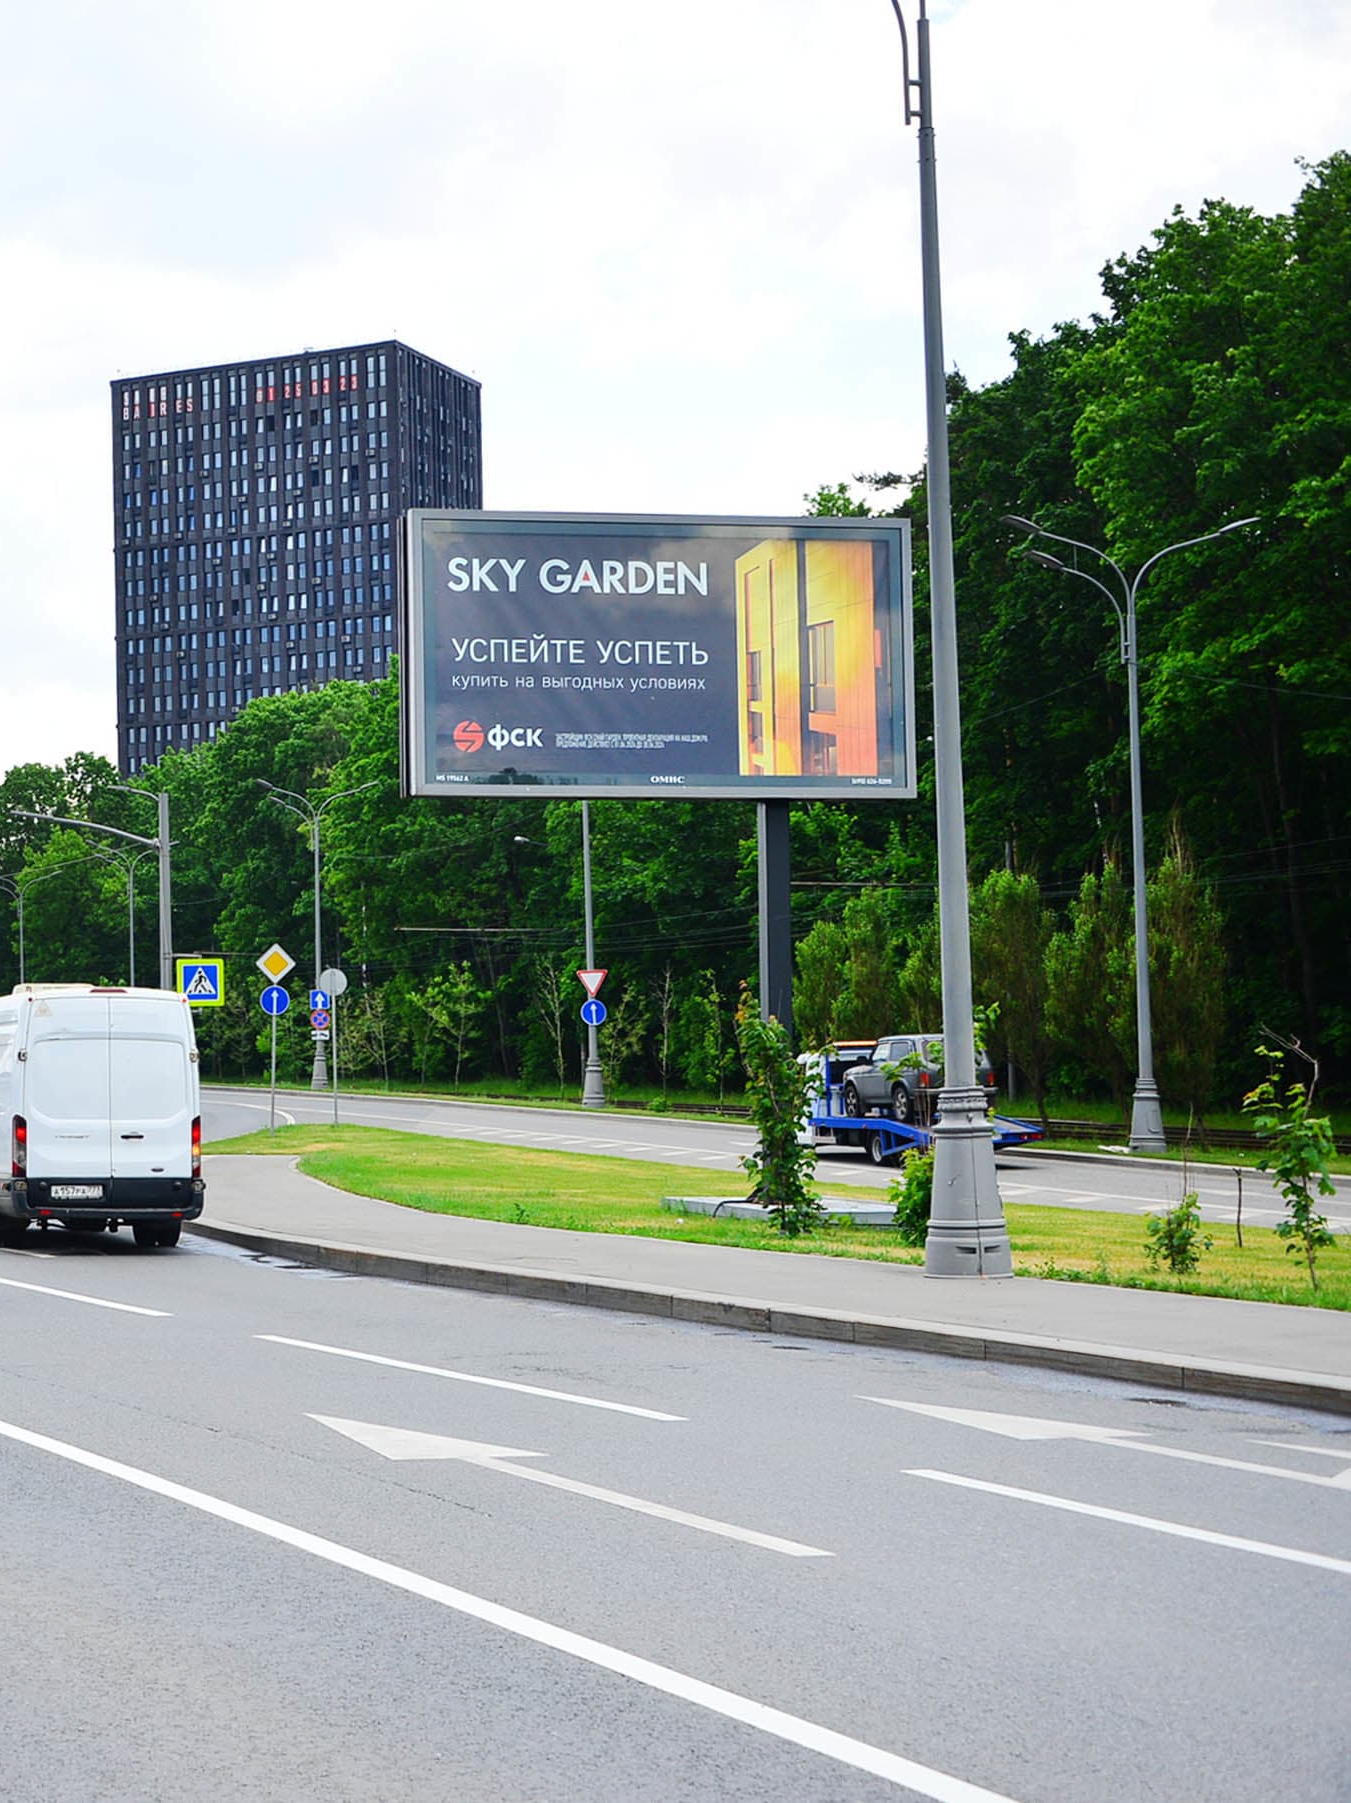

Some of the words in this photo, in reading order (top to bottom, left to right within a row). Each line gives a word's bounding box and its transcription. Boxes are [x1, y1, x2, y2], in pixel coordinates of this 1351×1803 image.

[447, 557, 526, 592] SKY
[538, 559, 709, 596] GARDEN
[451, 633, 585, 664] УСПЕЙТЕ
[596, 640, 709, 665] УСПЕТЬ
[452, 675, 508, 690] купить
[515, 676, 534, 689] на
[542, 676, 624, 691] выгодных
[630, 677, 706, 692] условиях
[487, 724, 544, 750] ФСК
